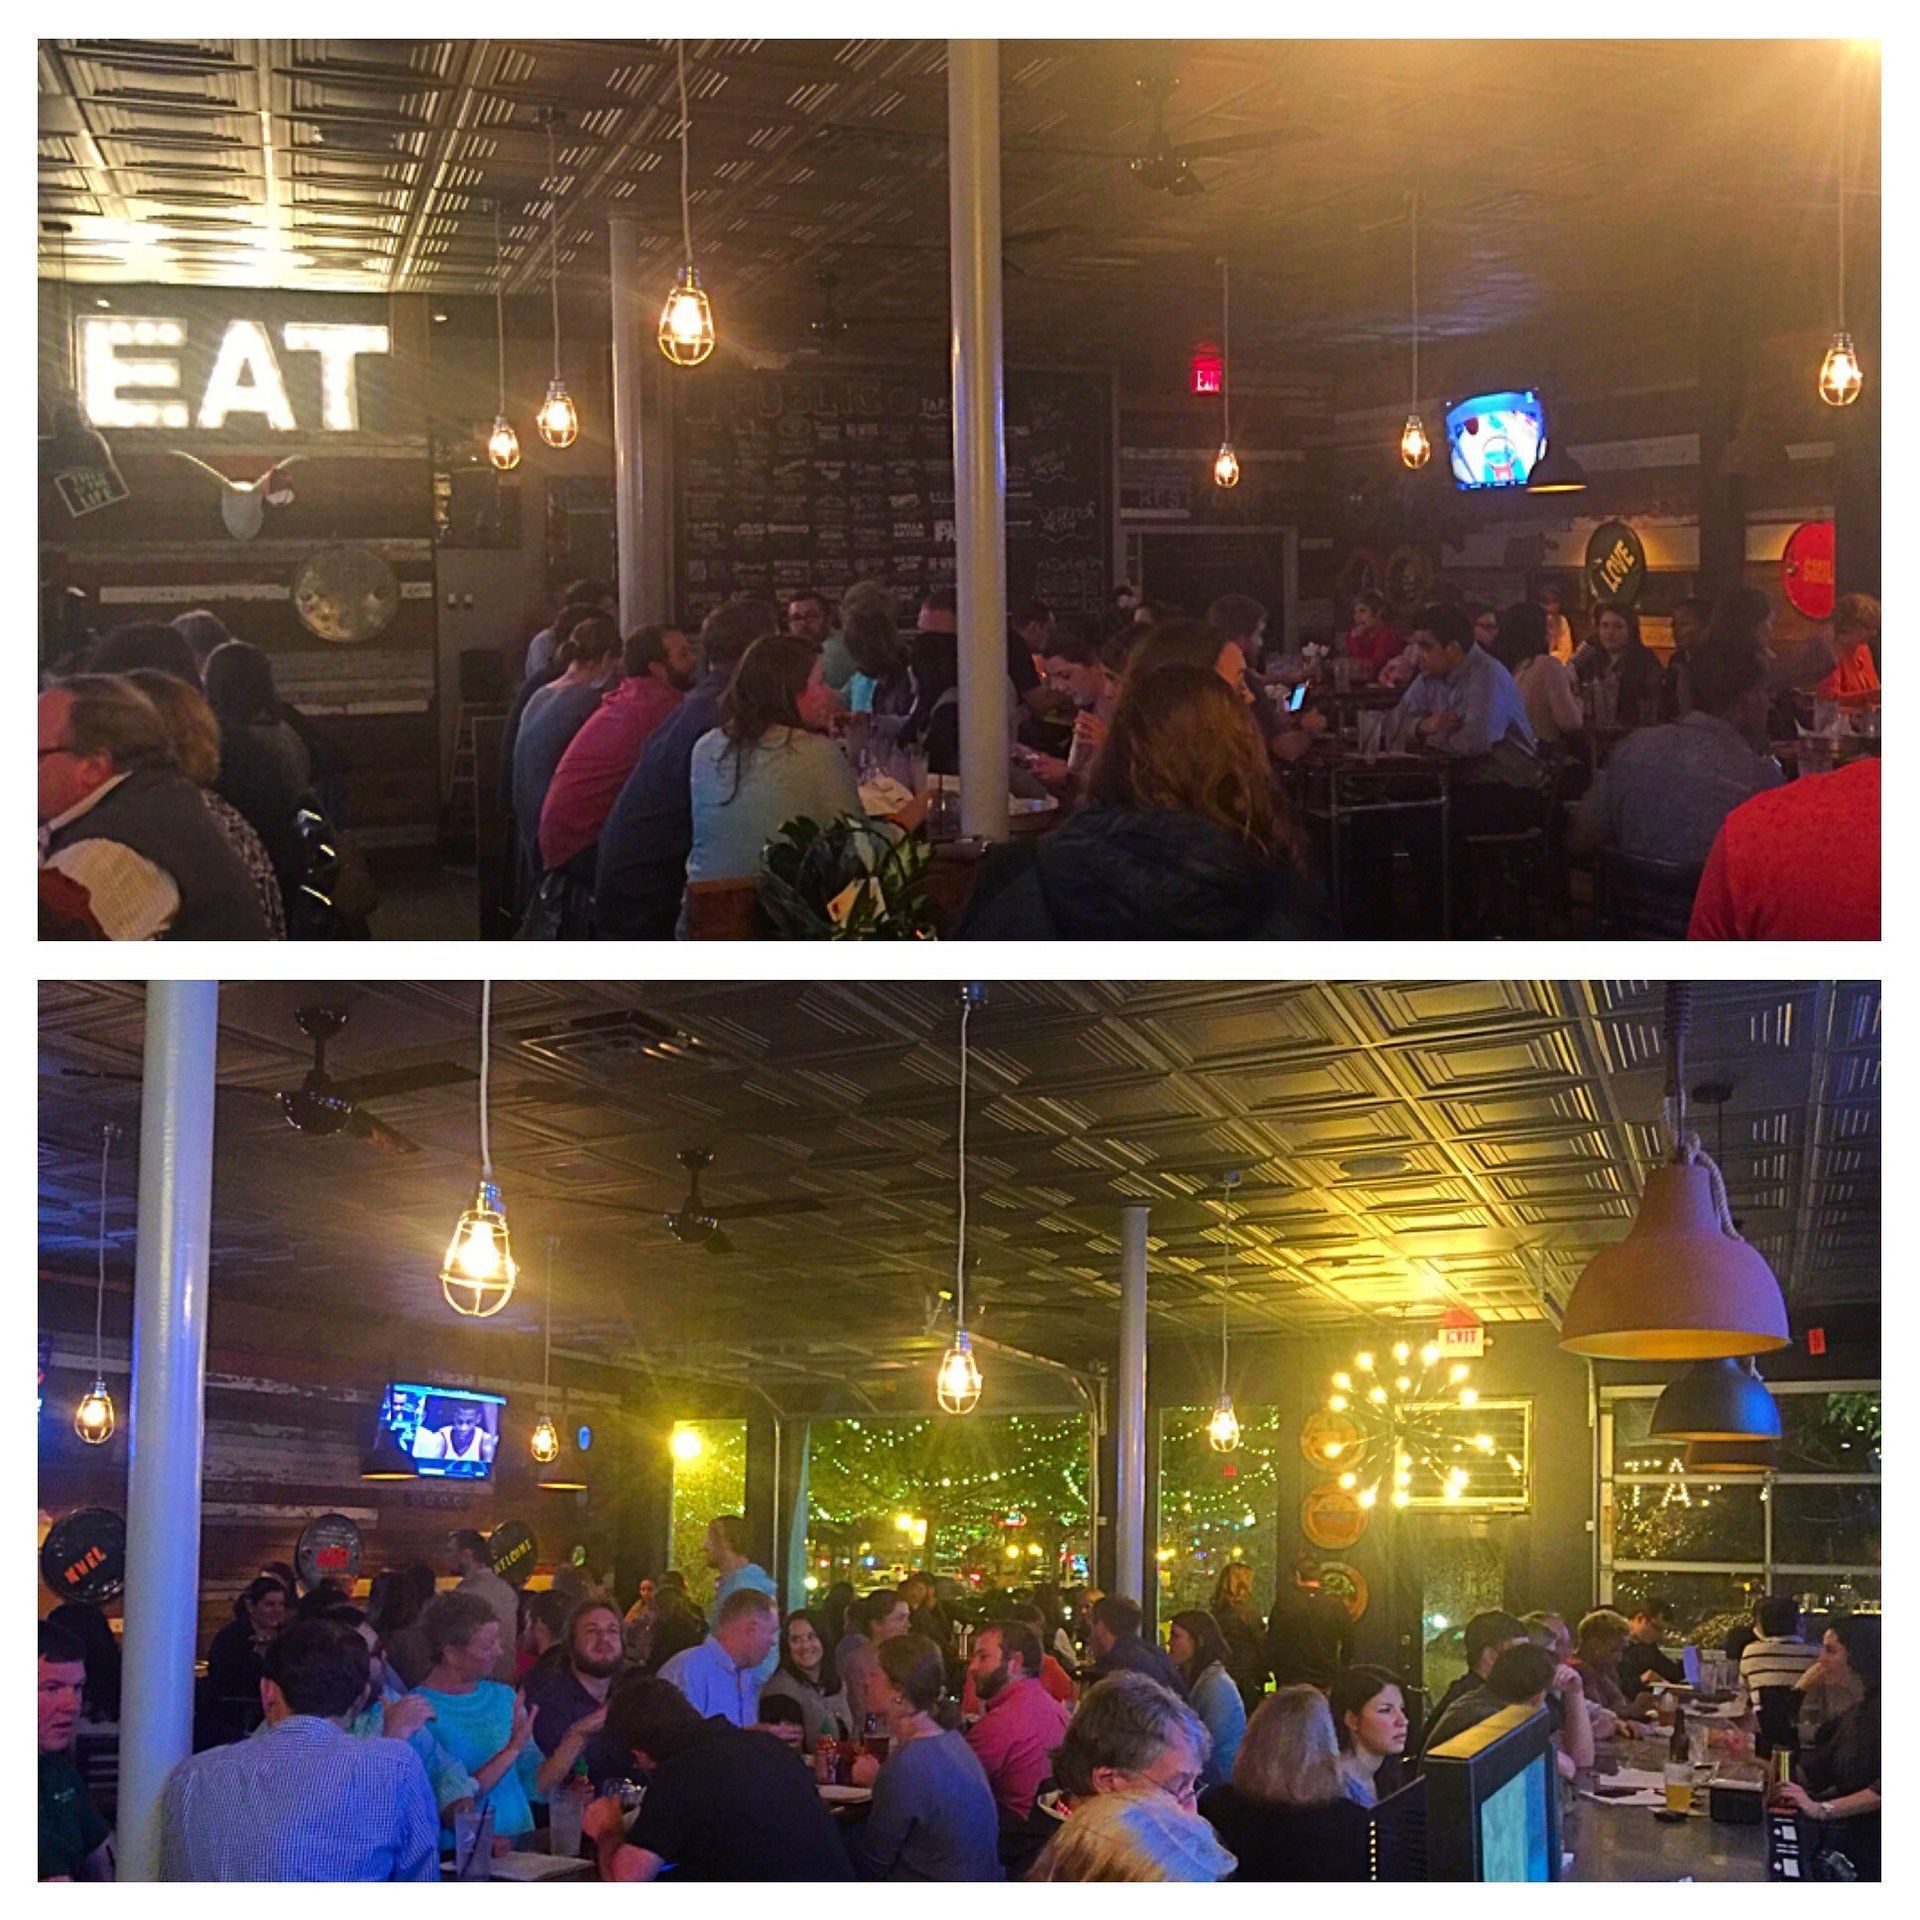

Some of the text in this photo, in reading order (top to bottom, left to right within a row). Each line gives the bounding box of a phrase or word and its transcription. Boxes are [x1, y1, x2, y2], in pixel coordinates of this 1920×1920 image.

[77, 315, 389, 431] EAT
[1600, 539, 1636, 594] LOVE
[1446, 1329, 1477, 1345] EXIT
